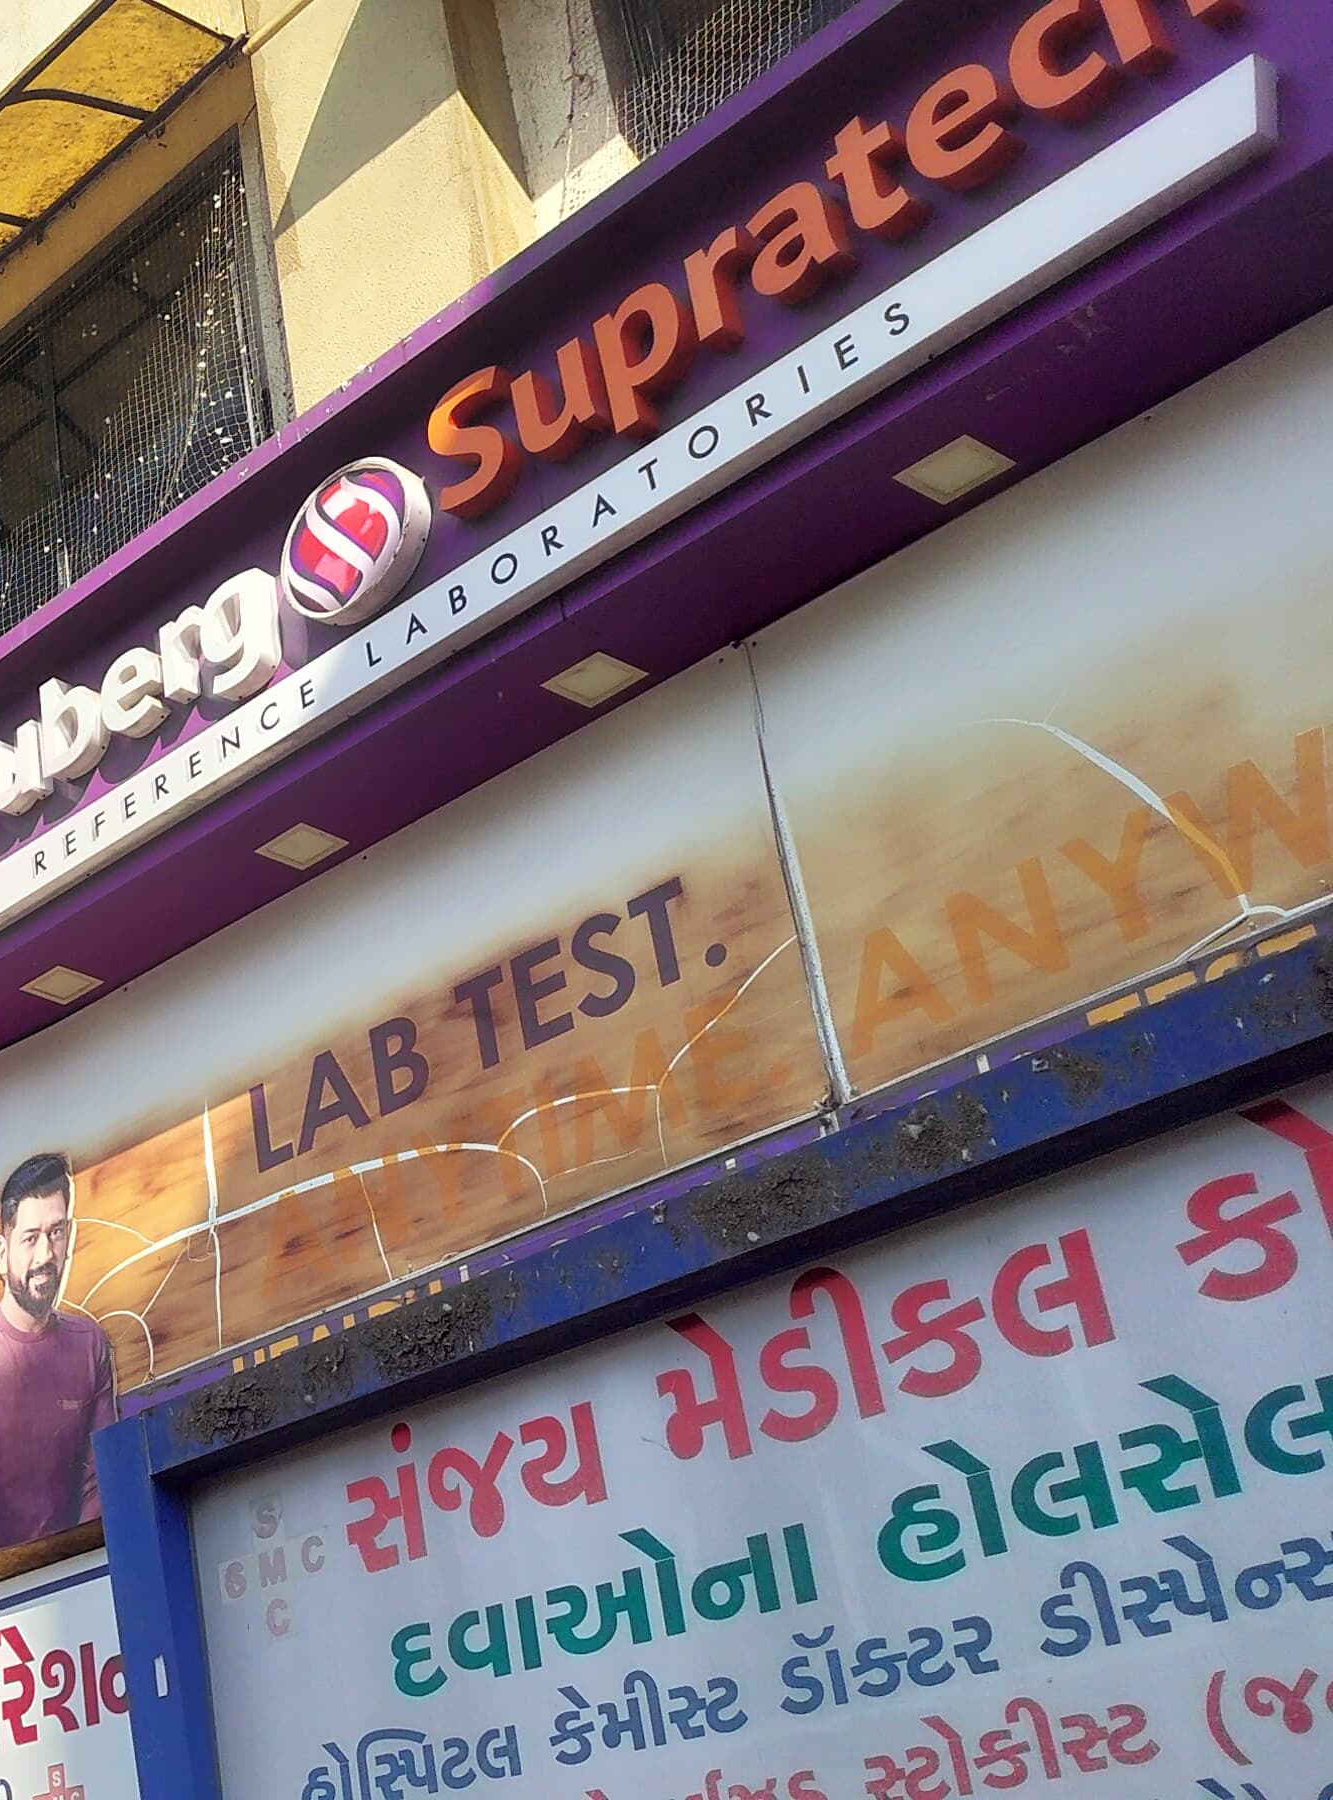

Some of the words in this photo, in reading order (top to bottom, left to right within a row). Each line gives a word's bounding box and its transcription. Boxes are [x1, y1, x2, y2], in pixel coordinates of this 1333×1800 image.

[426, 0, 1219, 512] Supratec
[33, 679, 316, 876] REFERENCE
[366, 301, 910, 668] LABORATORIES
[248, 1016, 430, 1174] LAB
[454, 876, 727, 1071] TEST.
[345, 1402, 608, 1574] સંજય
[656, 1228, 1117, 1460] મેડીકલ
[390, 1523, 818, 1697] દવાઓના
[549, 1669, 749, 1766] કેમીસ્ટ
